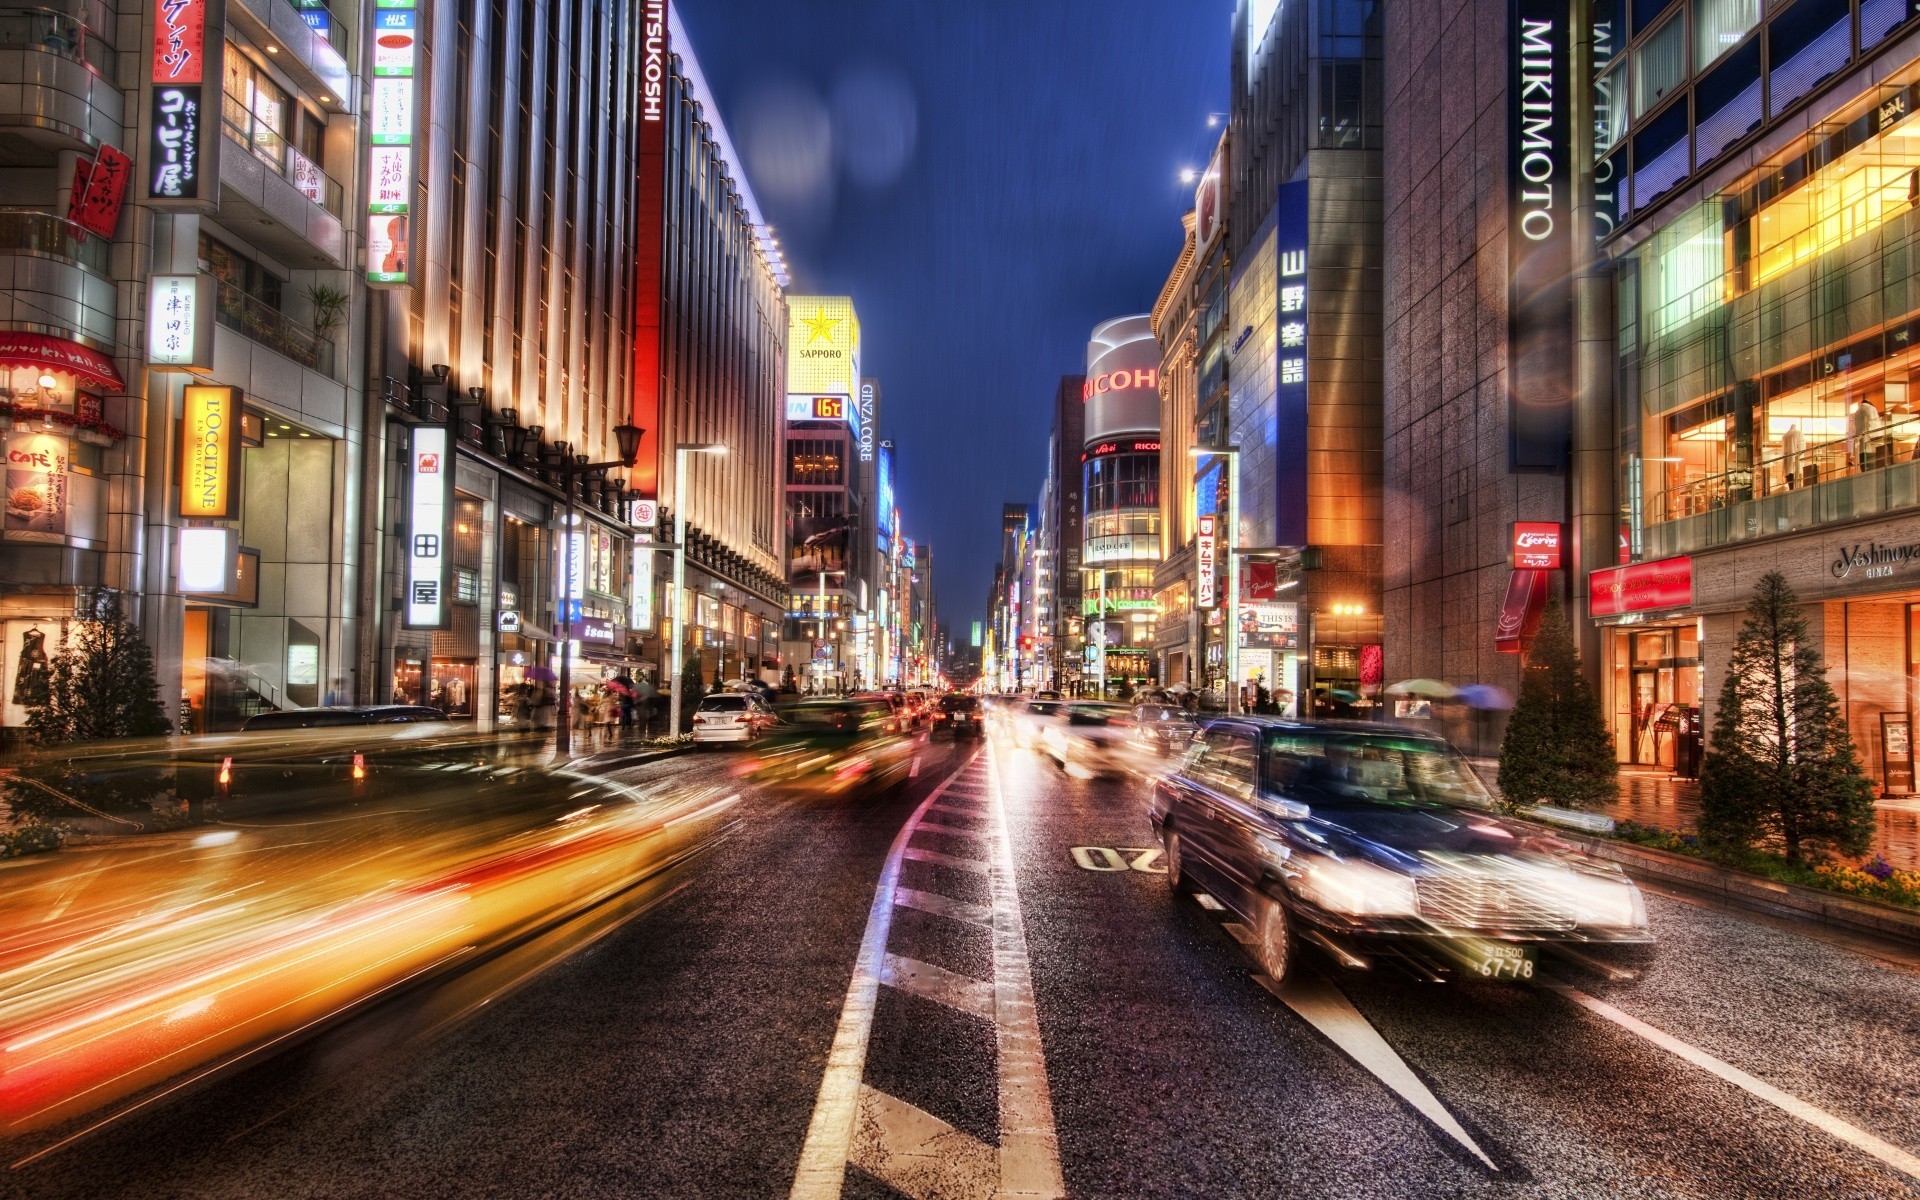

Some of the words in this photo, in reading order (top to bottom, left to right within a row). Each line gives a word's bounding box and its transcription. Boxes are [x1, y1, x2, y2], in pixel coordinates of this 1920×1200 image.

[644, 0, 663, 121] ITSUKOSHI
[155, 90, 184, 196] コーヒー屋
[1521, 18, 1554, 241] MIKIMOTO
[1282, 250, 1305, 384] 山野楽器
[800, 349, 842, 359] SAPPORO
[861, 384, 873, 425] GINZA
[1083, 368, 1157, 403] RICOH
[195, 437, 203, 489] PROVENCE
[202, 400, 222, 508] L'OCCITANE
[860, 428, 872, 462] CORE
[412, 533, 439, 605] 田屋
[1201, 541, 1212, 603] キムラヤのパン
[1832, 543, 1920, 579] Yoshinoya
[1866, 566, 1893, 579] GINZA
[1251, 580, 1275, 595] Fender
[1261, 614, 1281, 622] THIS
[1481, 958, 1534, 979] 67-78
[1505, 946, 1524, 959] 500
